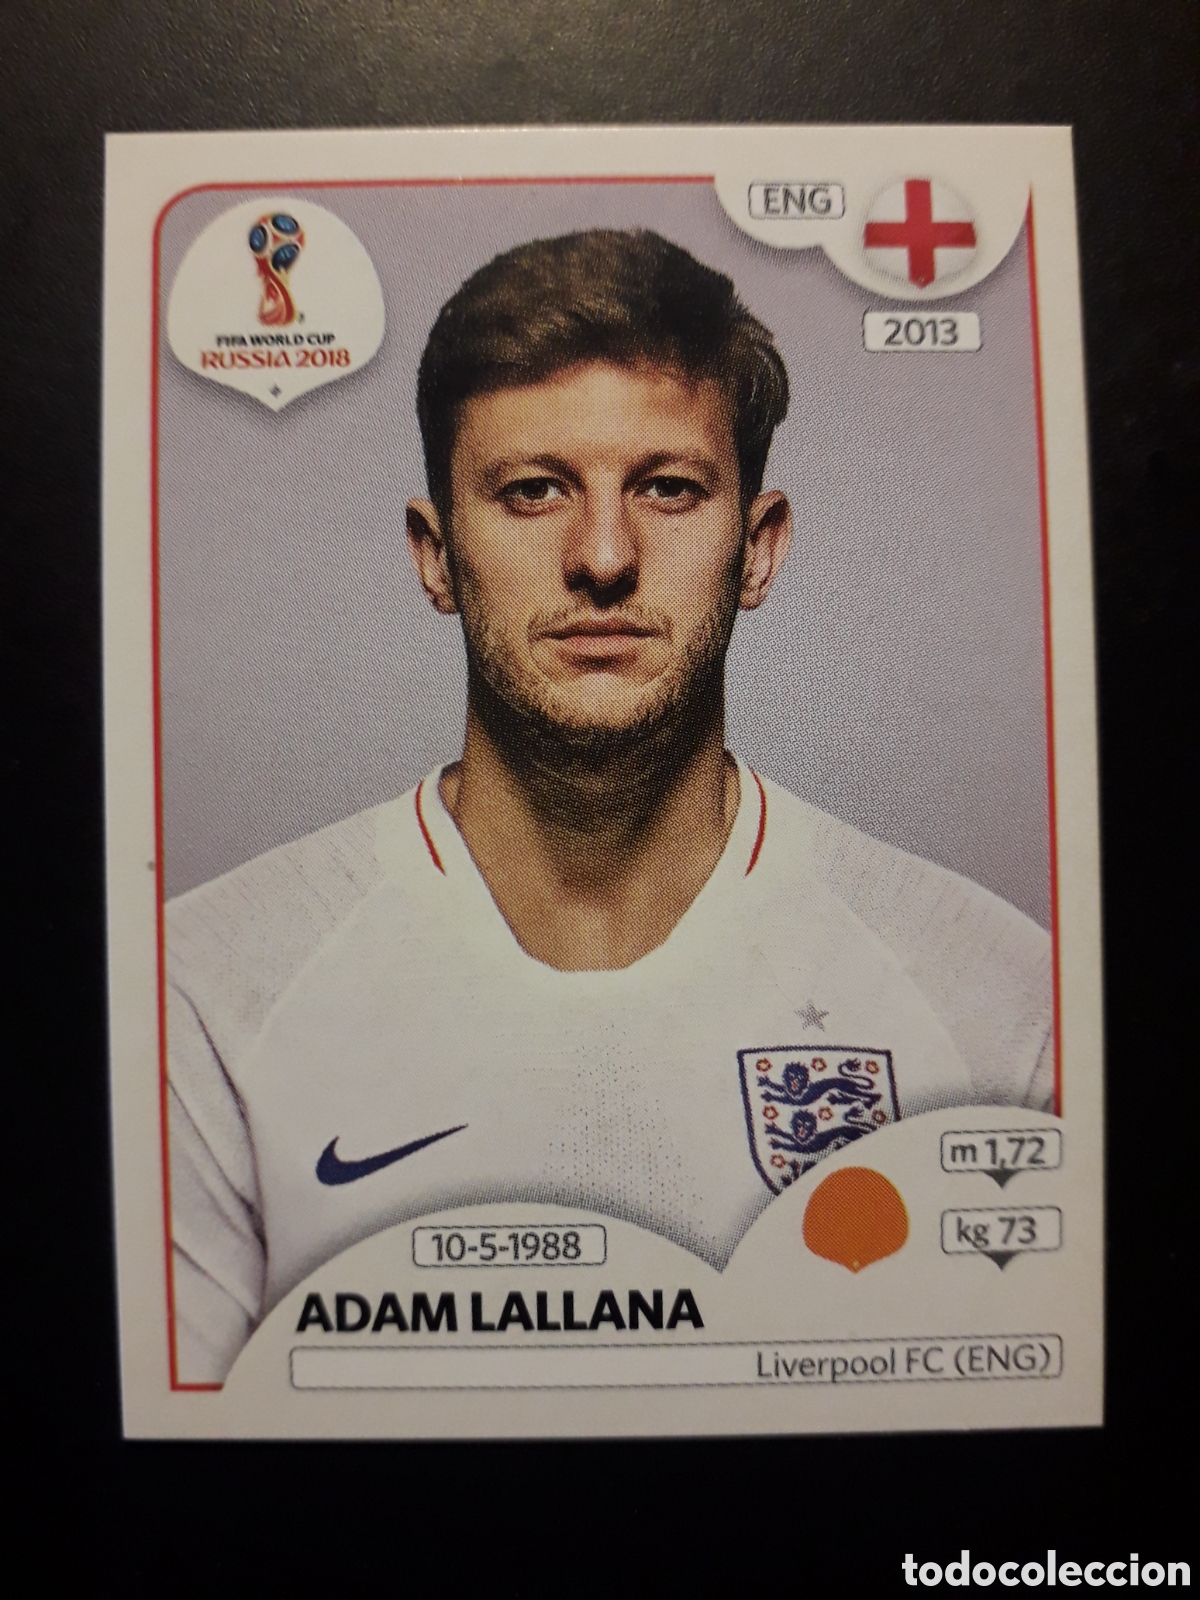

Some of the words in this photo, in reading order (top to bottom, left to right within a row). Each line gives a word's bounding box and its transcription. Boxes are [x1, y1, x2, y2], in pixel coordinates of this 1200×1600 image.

[762, 186, 832, 215] ENG
[215, 333, 248, 348] FIFA
[250, 333, 304, 346] WORLD
[307, 332, 336, 346] CUP
[883, 318, 959, 347] 2013
[201, 350, 291, 370] RUSSIA
[295, 348, 352, 368] 2018
[949, 1141, 978, 1165] m
[984, 1135, 1047, 1170] 1,72
[430, 1230, 583, 1262] 10-5-1988
[956, 1217, 990, 1248] kg
[997, 1215, 1038, 1245] 73
[295, 1290, 459, 1333] ADAM
[470, 1287, 706, 1332] LALLANA
[756, 1346, 896, 1384] Liverpool
[905, 1345, 944, 1375] FC
[953, 1341, 1052, 1377] (ENG)
